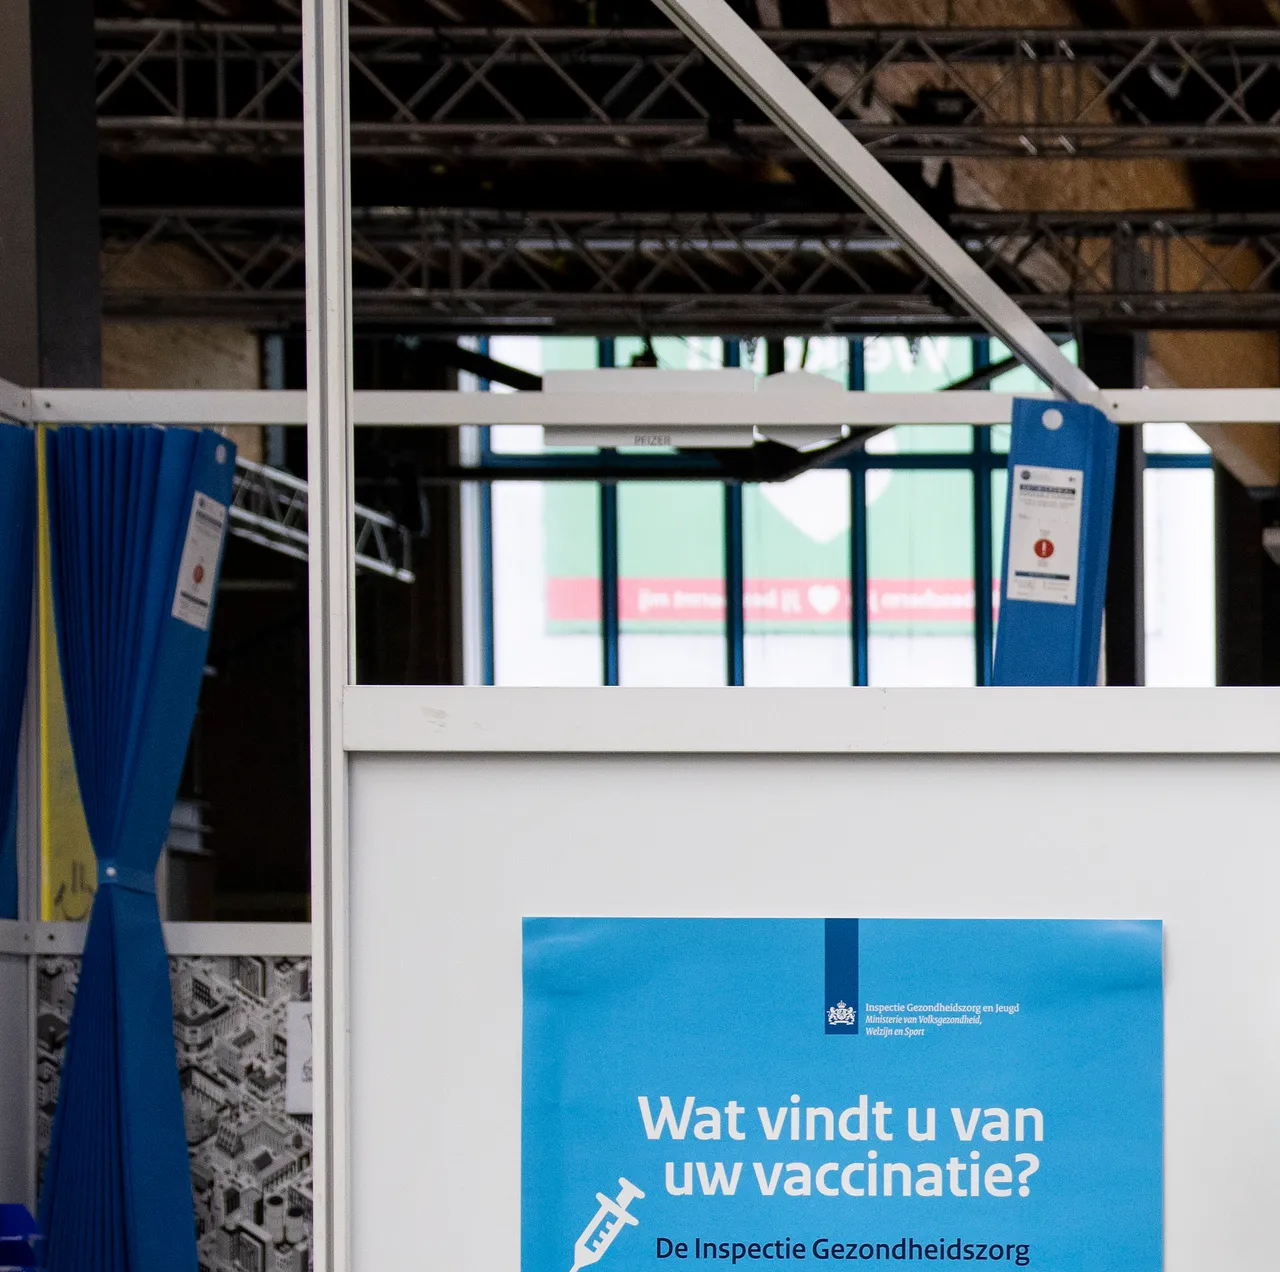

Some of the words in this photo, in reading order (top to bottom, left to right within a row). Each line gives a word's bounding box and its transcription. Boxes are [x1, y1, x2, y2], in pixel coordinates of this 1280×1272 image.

[633, 434, 672, 446] PFIZER
[866, 1003, 905, 1013] Inspectie
[907, 1003, 981, 1014] Gezondheidszorg
[996, 1004, 1019, 1014] Jeugd
[865, 1015, 902, 1023] Ministerie
[919, 1014, 982, 1026] Volksgezondheid,
[866, 1027, 893, 1037] Welzijn
[904, 1027, 924, 1037] Sport
[638, 1096, 745, 1140] Wat
[757, 1094, 893, 1141] vindt
[908, 1108, 935, 1141] u
[951, 1108, 1043, 1141] van
[666, 1162, 743, 1195] uw
[753, 1150, 1039, 1197] vaccinatie?
[657, 1238, 688, 1258] De
[696, 1237, 805, 1264] Inspectie
[813, 1238, 1029, 1266] Gezondheidszorg
